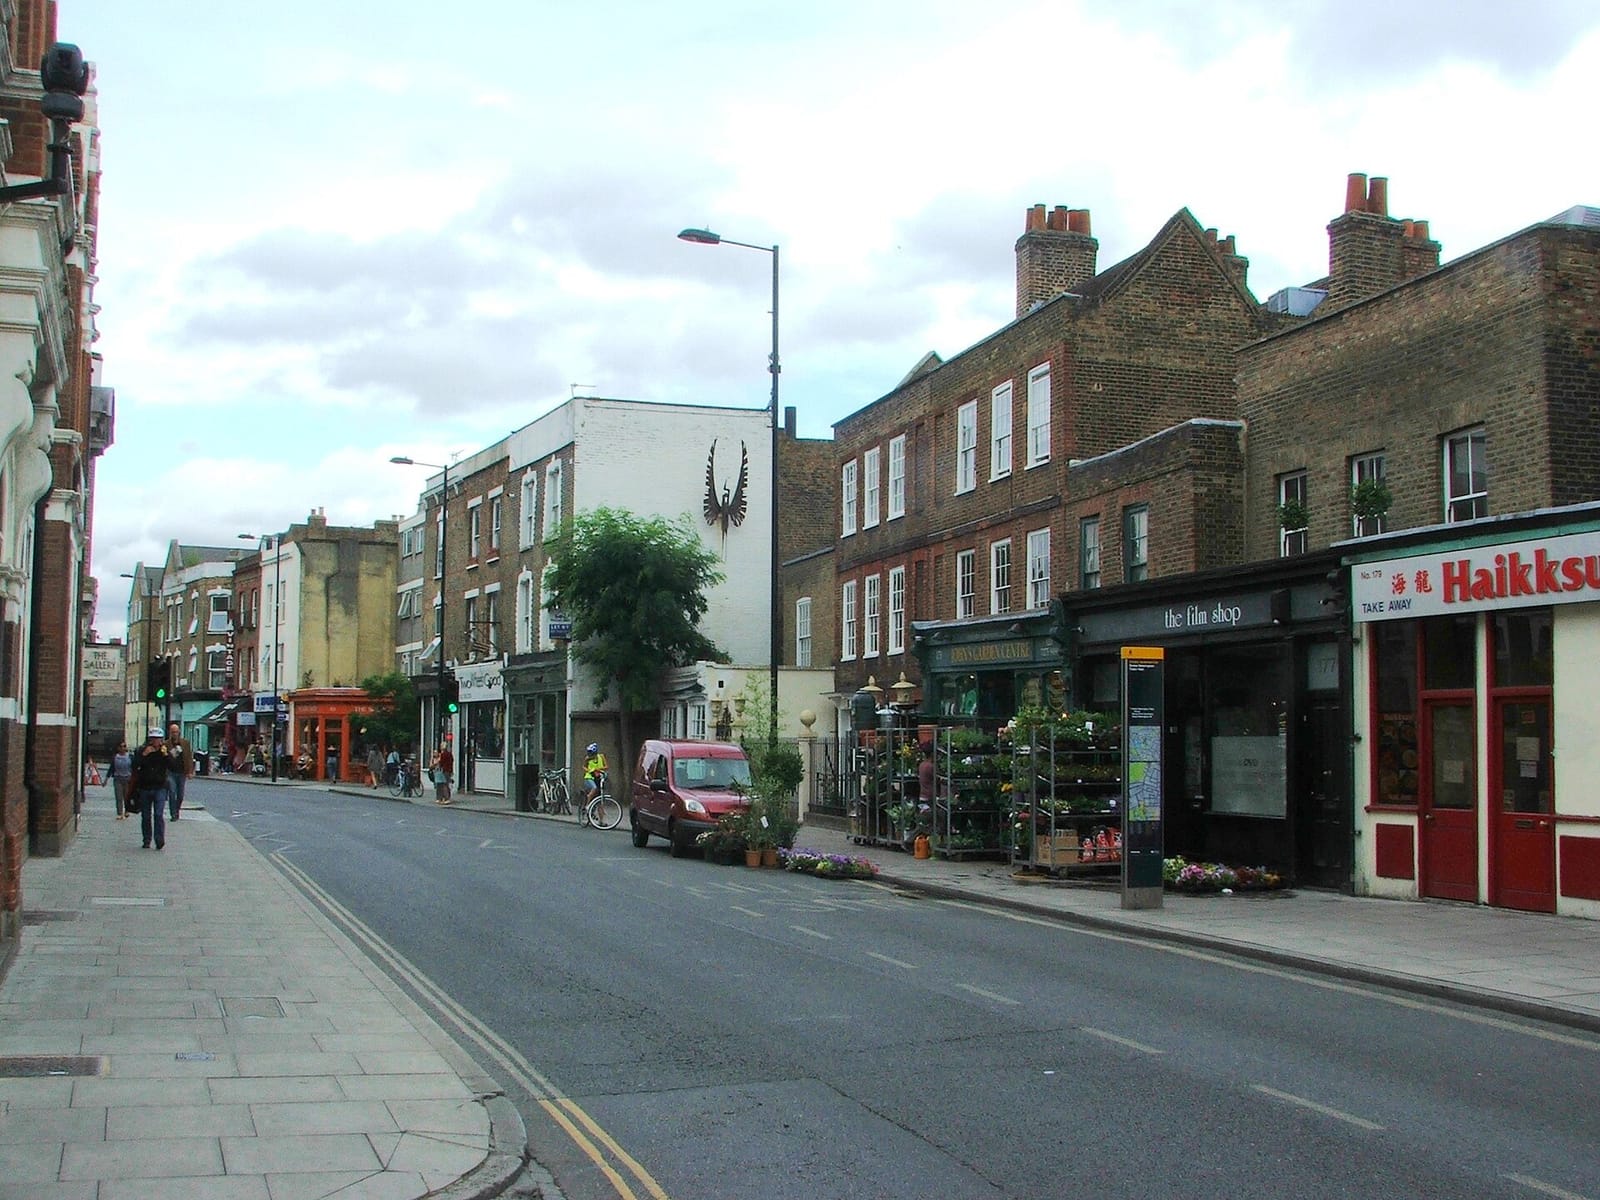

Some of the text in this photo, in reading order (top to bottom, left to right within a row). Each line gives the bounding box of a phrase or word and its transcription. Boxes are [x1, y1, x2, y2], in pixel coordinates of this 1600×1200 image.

[1361, 599, 1412, 614] TAKE AWAY
[1164, 602, 1241, 629] the film shop
[93, 651, 107, 660] THE
[83, 659, 116, 669] GALLERY
